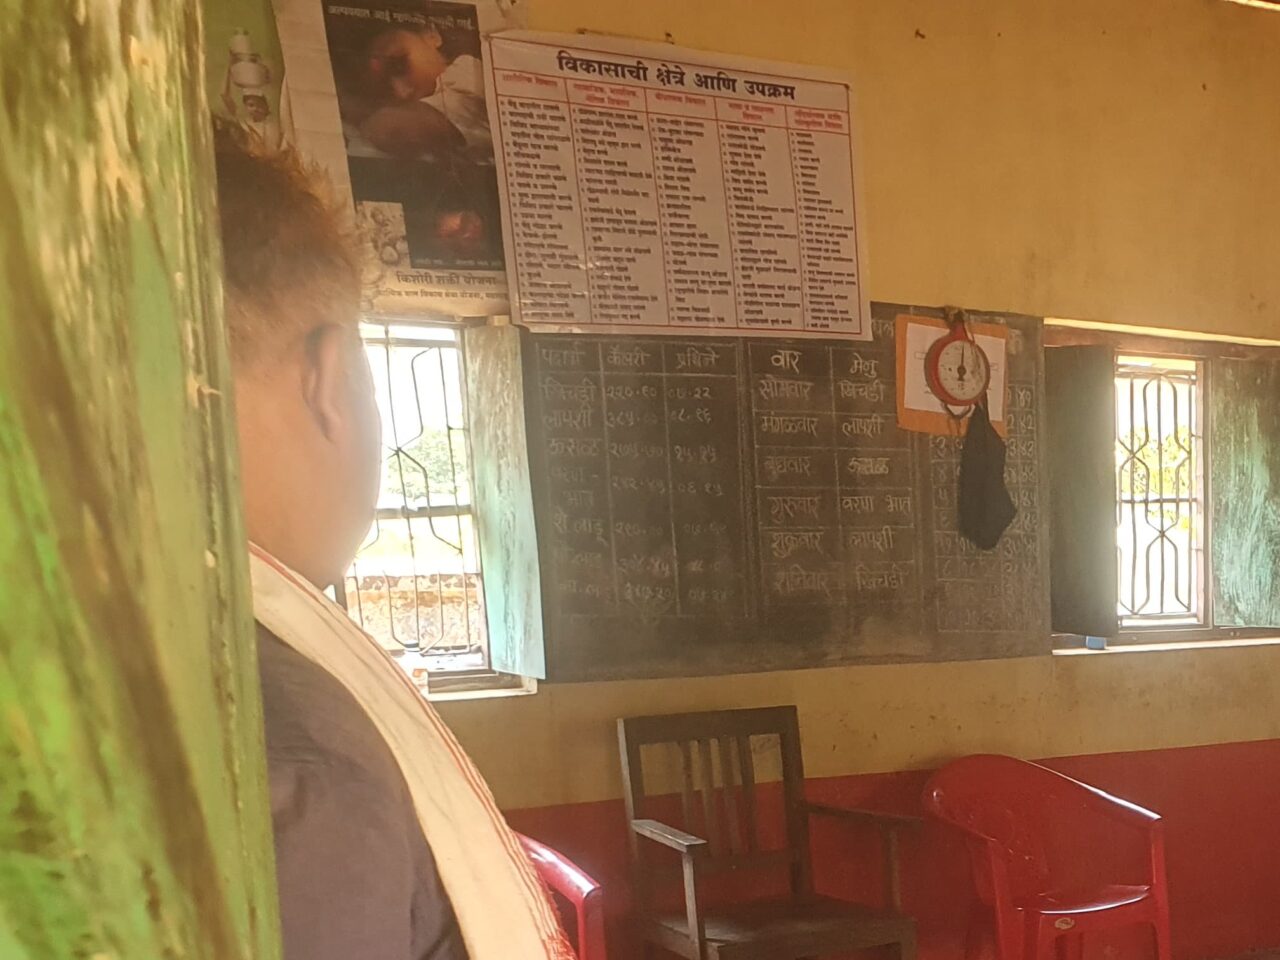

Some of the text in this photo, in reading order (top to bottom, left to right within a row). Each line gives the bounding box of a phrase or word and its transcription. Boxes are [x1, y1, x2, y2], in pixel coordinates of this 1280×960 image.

[556, 49, 796, 100] विकासाची क्षेत्रे आणि उपक्रम
[396, 270, 433, 285] किशोरी
[770, 348, 879, 378] वार मेनु
[760, 374, 886, 402] सोमवार खिचडी
[761, 411, 885, 438] मंगळवार लापशी
[885, 494, 913, 516] भात
